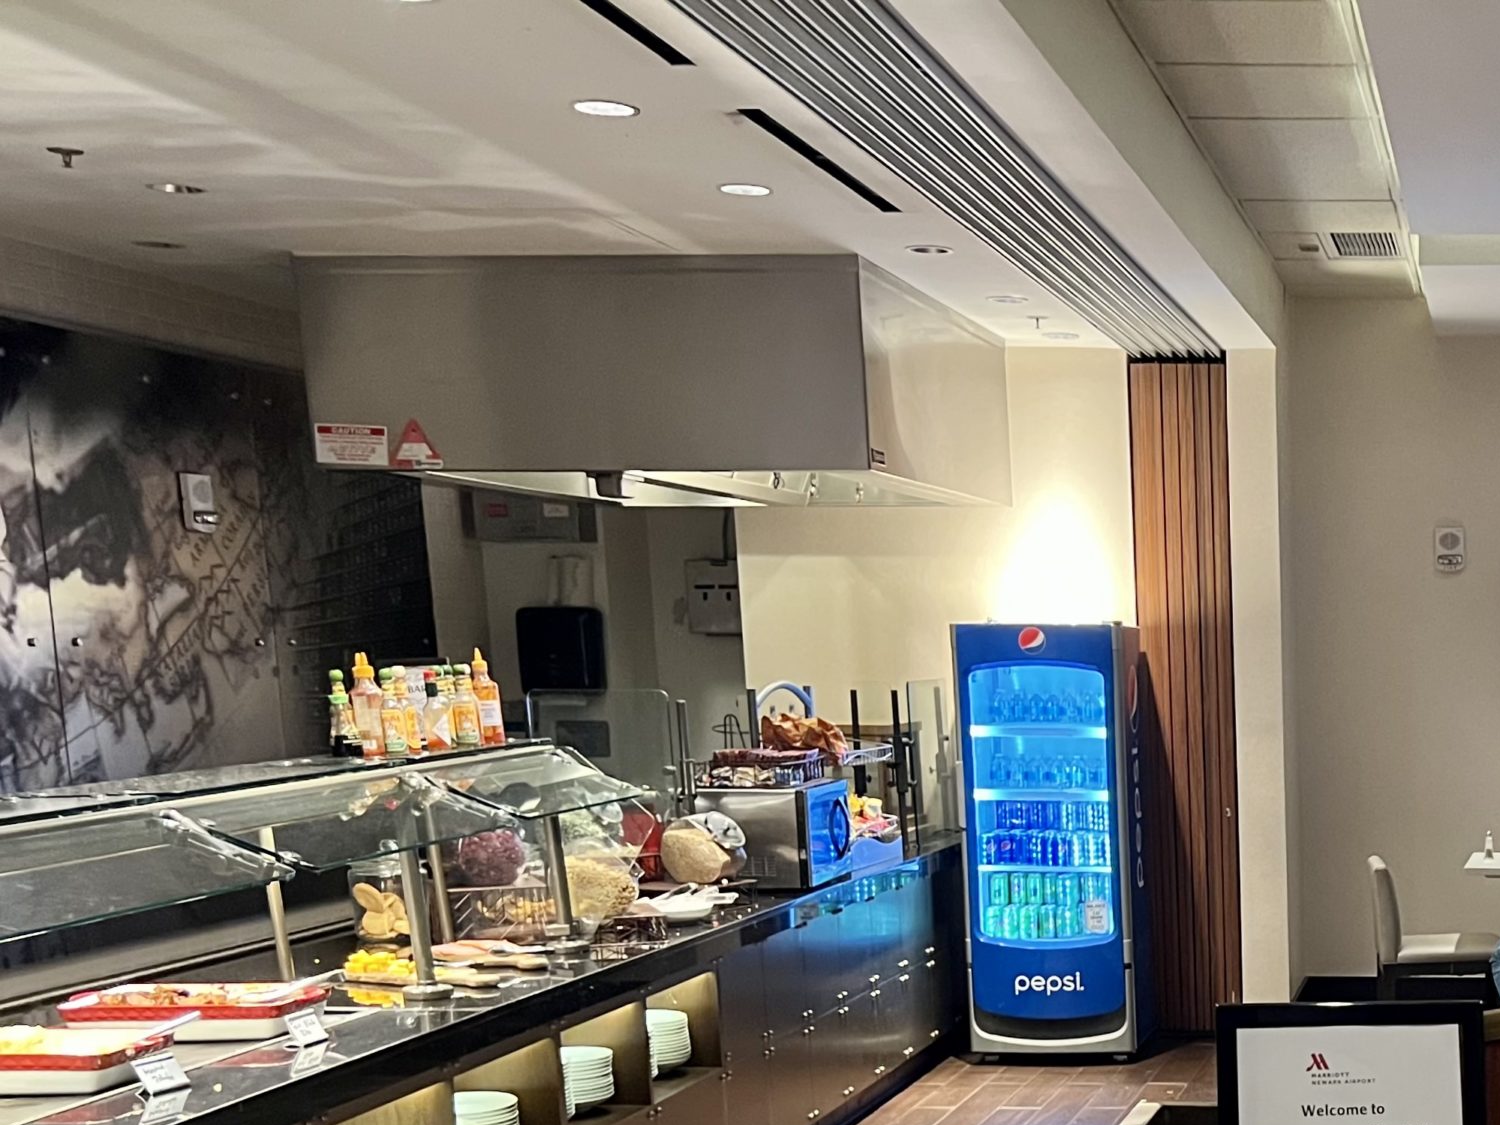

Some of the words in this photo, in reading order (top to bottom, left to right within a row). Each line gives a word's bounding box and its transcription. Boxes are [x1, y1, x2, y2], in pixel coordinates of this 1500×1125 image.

[331, 426, 371, 435] CAUTION
[1301, 1103, 1368, 1118] Welcome
[1370, 1103, 1386, 1116] to
